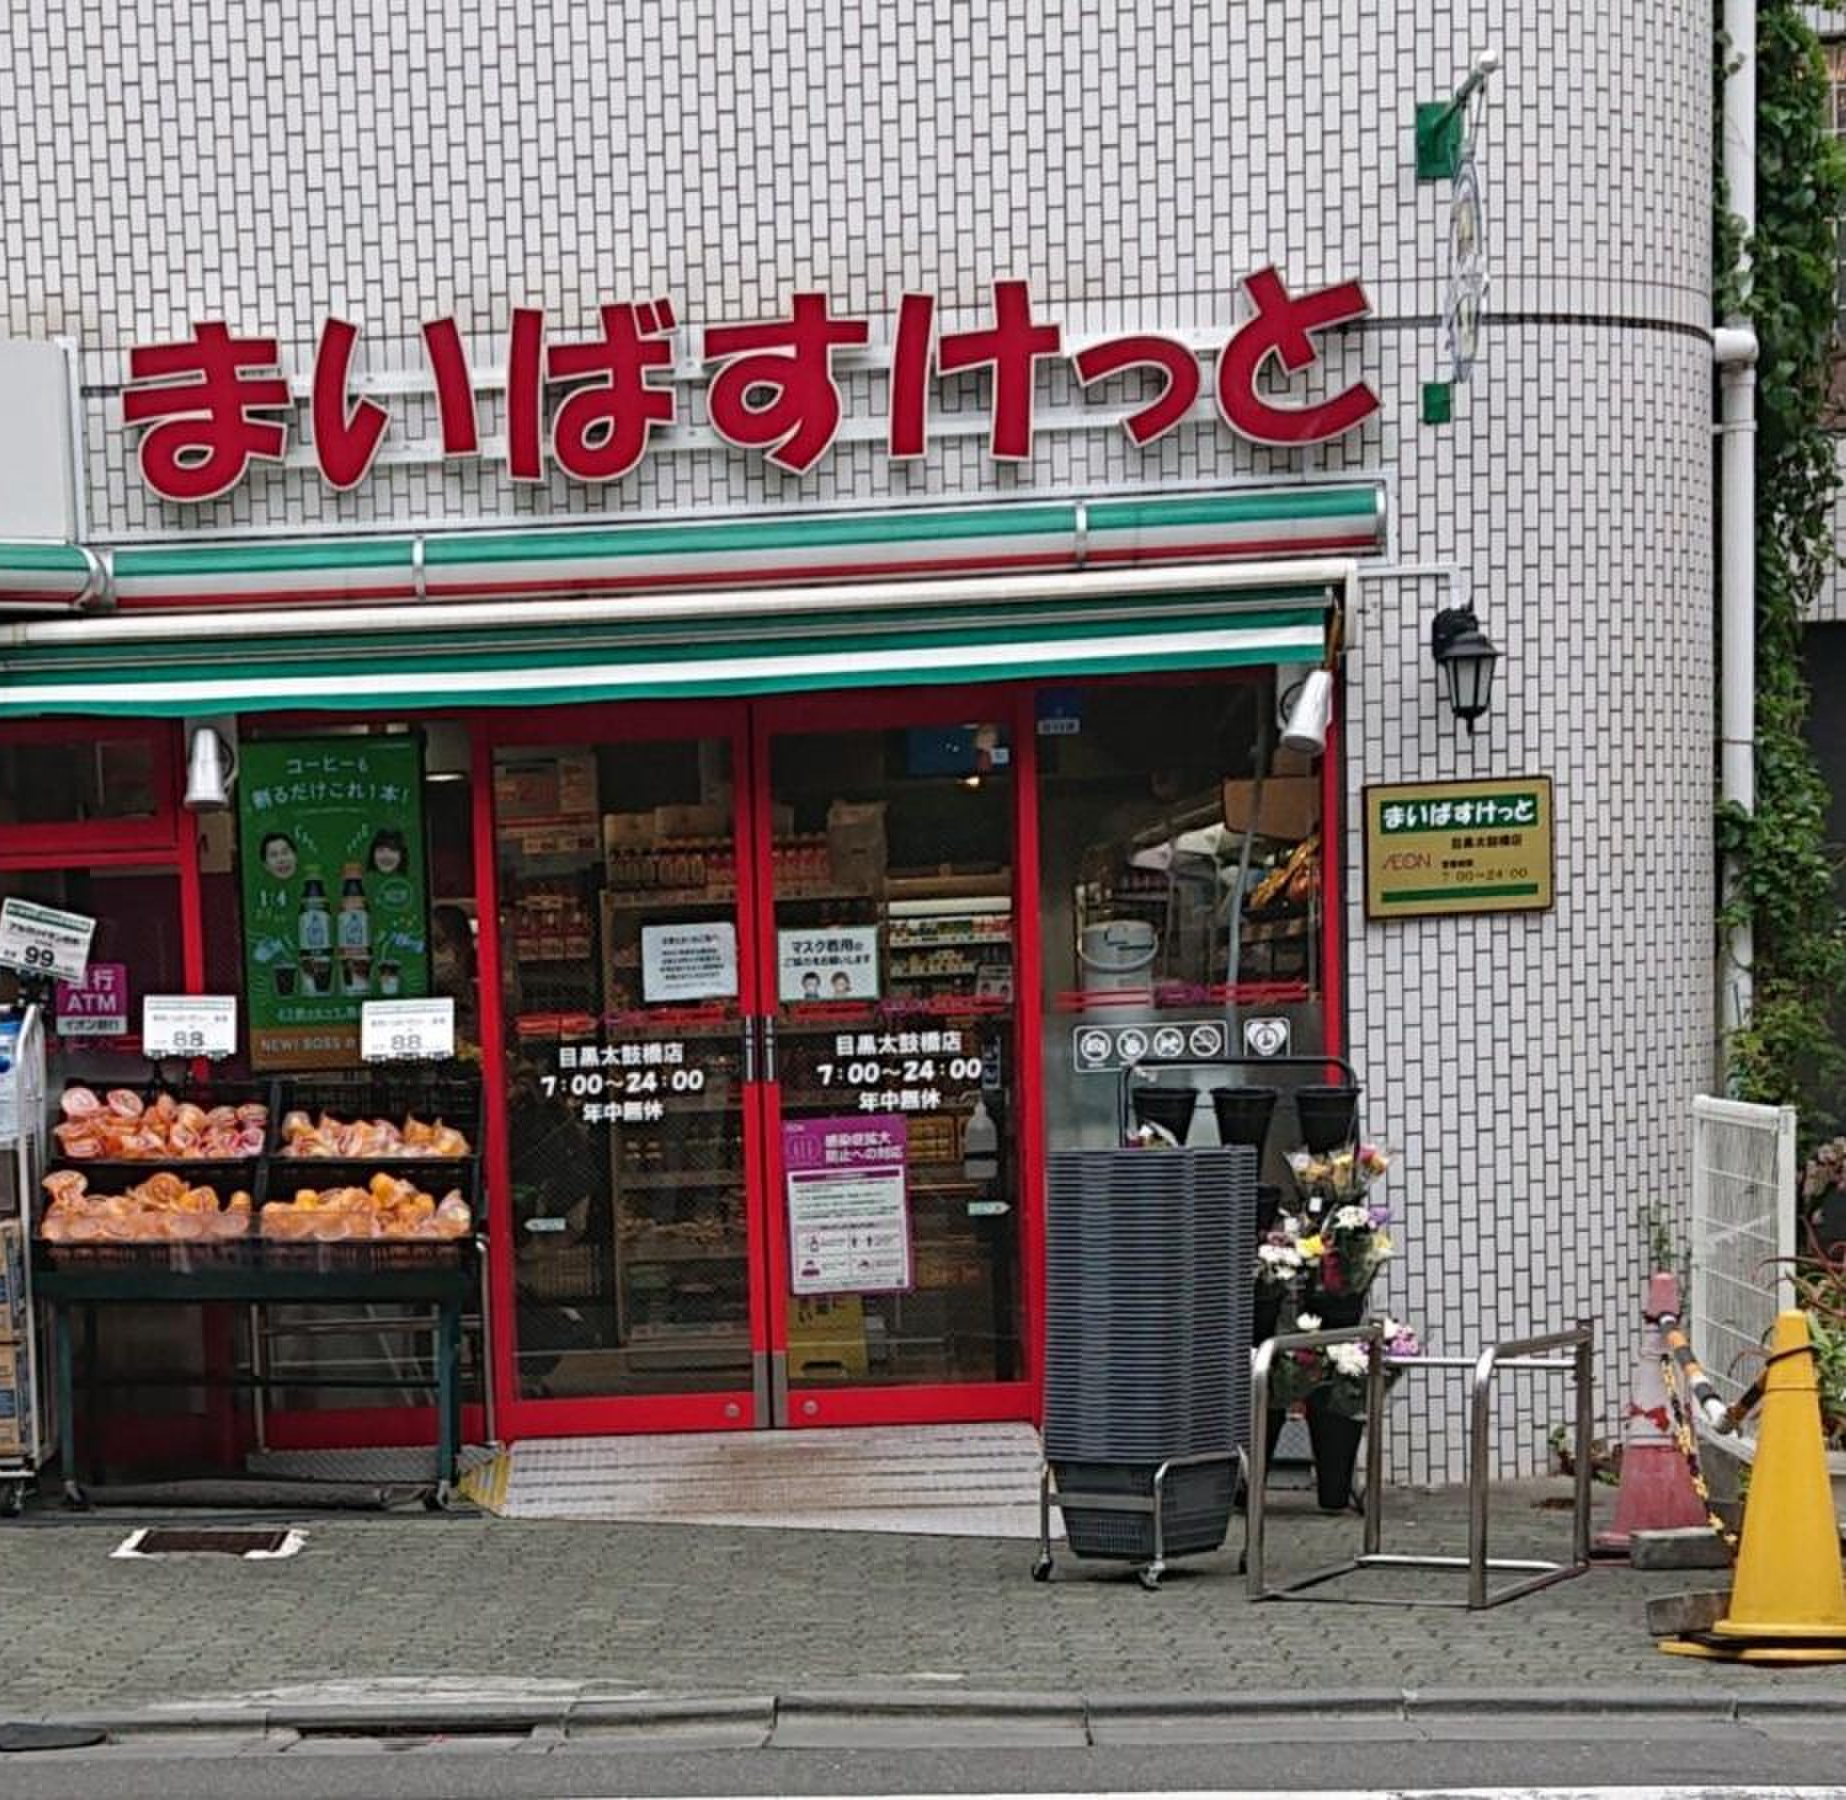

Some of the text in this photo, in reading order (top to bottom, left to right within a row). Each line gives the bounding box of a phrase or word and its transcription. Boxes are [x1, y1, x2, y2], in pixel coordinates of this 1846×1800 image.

[120, 262, 1383, 503] まいばすけっと
[1384, 799, 1534, 829] まいばすけっと
[25, 945, 55, 967] 99
[67, 993, 117, 1012] ATM
[173, 1030, 204, 1047] 88
[391, 1034, 422, 1051] 88
[835, 1031, 962, 1057] 目黒太鼓橋店
[558, 1042, 684, 1069] 目黒太鼓橋店
[858, 1090, 941, 1112] 年中無休
[582, 1101, 663, 1124] 年中無休
